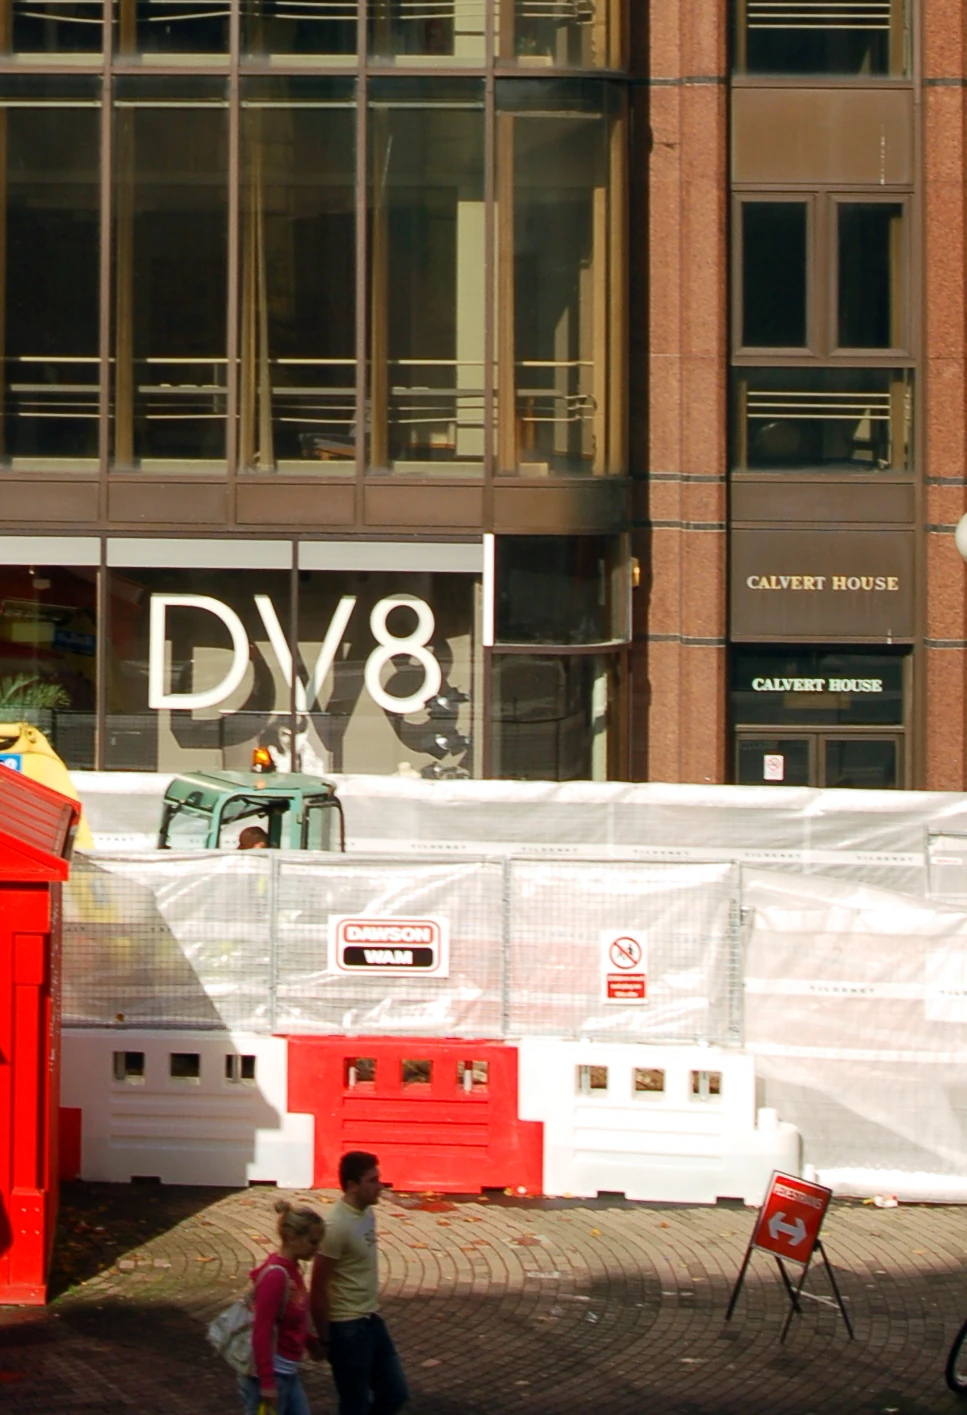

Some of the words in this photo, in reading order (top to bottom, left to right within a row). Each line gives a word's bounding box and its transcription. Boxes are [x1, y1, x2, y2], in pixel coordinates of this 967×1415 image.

[746, 575, 826, 590] CALVERT
[832, 576, 899, 591] HOUSE
[148, 592, 442, 714] DV8
[751, 678, 826, 692] CALVERT
[828, 679, 883, 692] HOUSE
[347, 926, 430, 942] DAWSON
[363, 949, 413, 965] WAM
